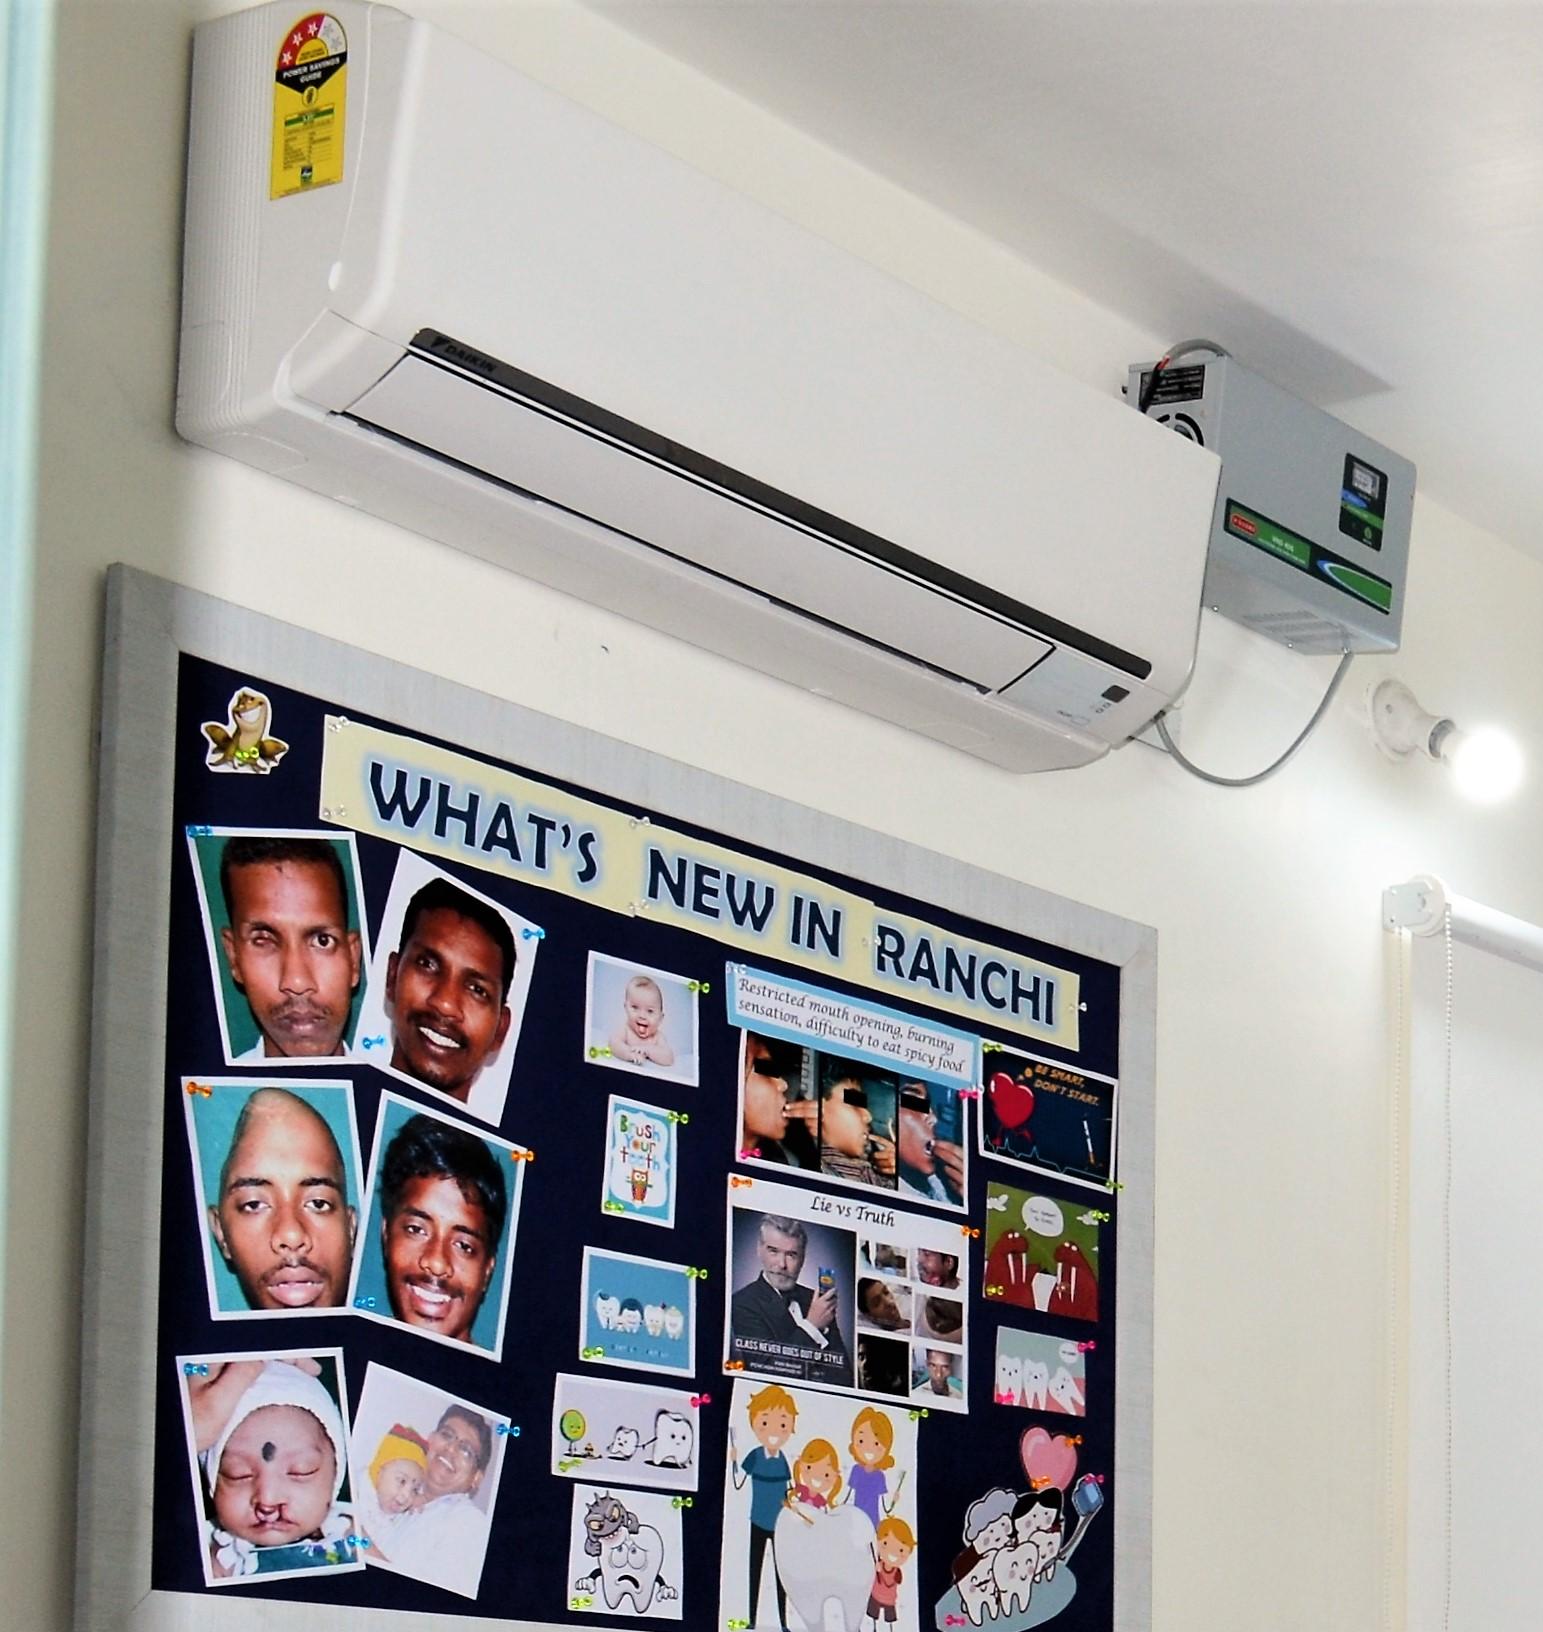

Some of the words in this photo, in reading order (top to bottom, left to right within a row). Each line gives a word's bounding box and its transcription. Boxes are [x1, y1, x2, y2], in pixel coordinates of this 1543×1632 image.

[283, 65, 308, 78] POWER
[444, 345, 497, 373] DAIKIN
[369, 761, 598, 885] WHAT'S
[647, 848, 775, 933] NEW
[790, 895, 842, 958] IN
[875, 924, 1056, 1027] RANCHI
[738, 977, 807, 1008] Restricted
[808, 999, 850, 1022] mouth
[853, 1014, 904, 1039] opening,
[907, 1026, 955, 1054] burning
[738, 1000, 803, 1028] sensation,
[806, 1015, 865, 1045] difficulty
[867, 1034, 880, 1049] to
[882, 1041, 902, 1055] eat
[904, 1047, 935, 1069] spicy
[937, 1055, 966, 1074] food
[810, 1196, 832, 1213] Lie
[836, 1204, 852, 1217] vs
[856, 1205, 895, 1227] Truth
[735, 1338, 758, 1351] CLASS
[823, 1353, 844, 1365] STYLE
